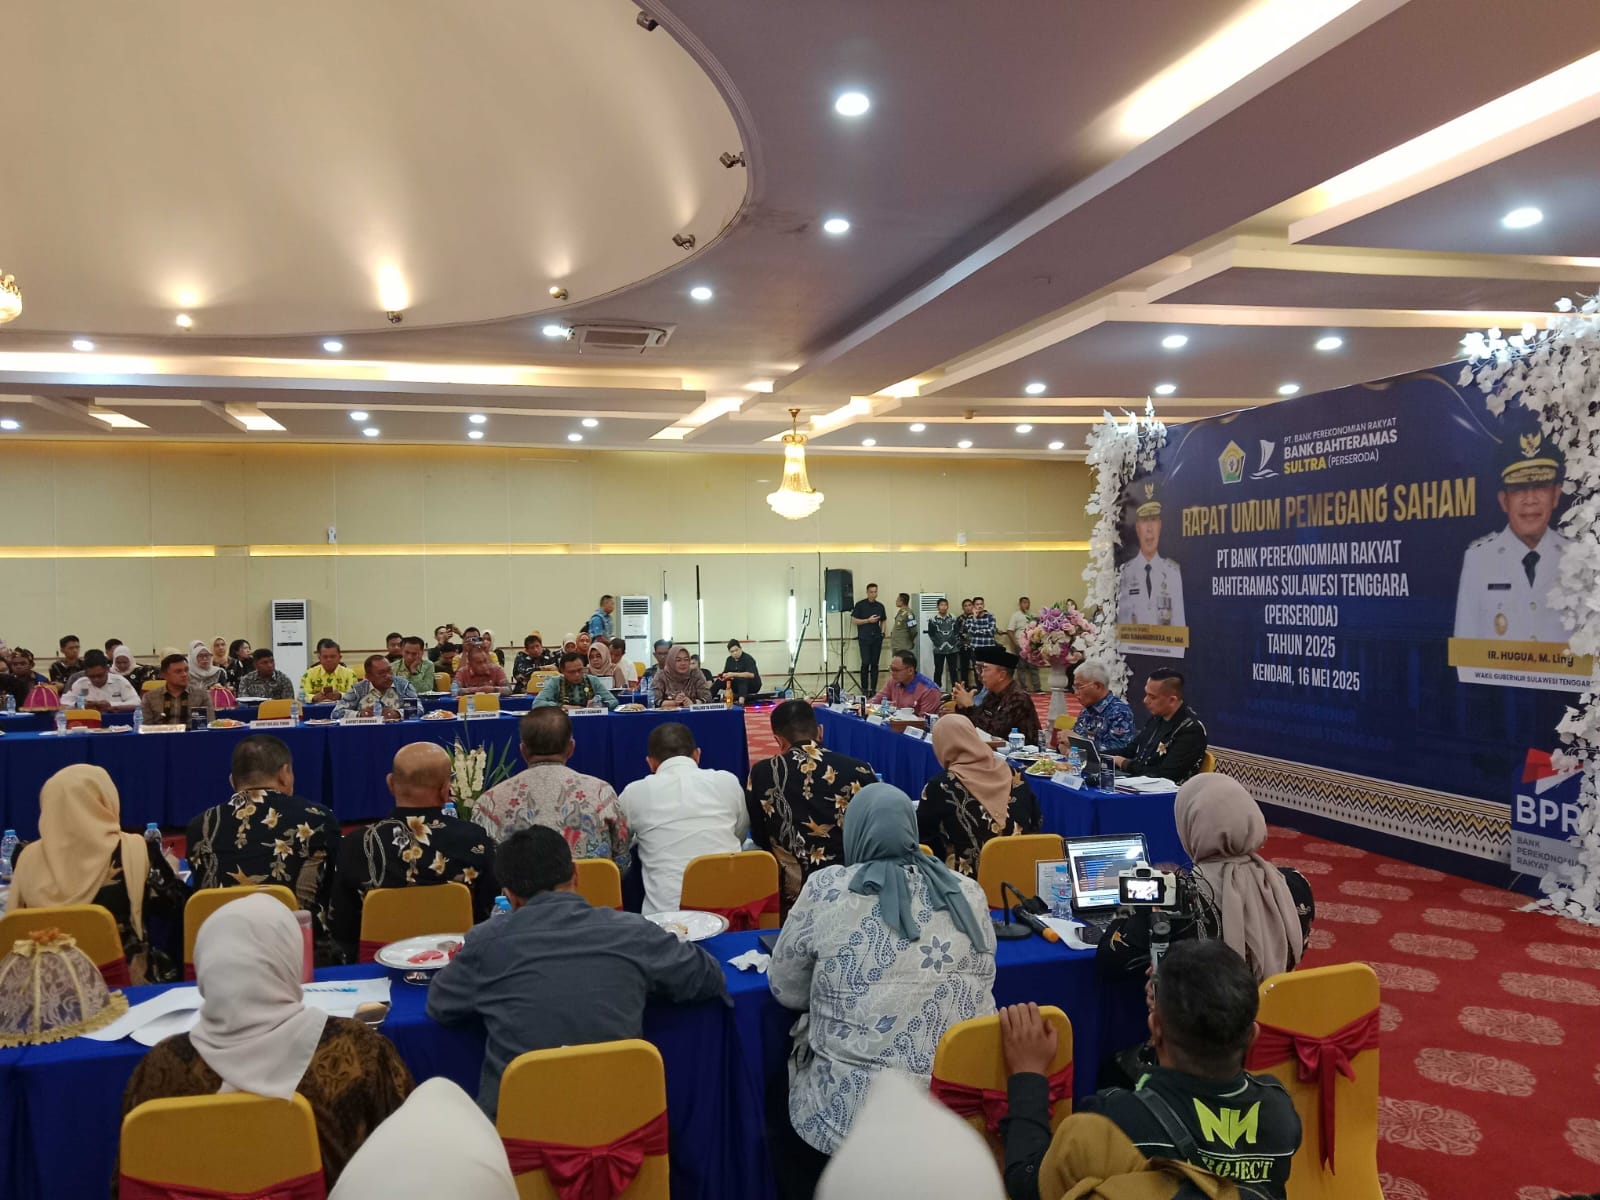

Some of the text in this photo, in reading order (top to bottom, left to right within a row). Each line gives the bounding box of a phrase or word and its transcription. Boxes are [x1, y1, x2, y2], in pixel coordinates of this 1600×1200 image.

[1294, 432, 1312, 443] BANK
[1312, 422, 1367, 439] PEREKONOMIAN
[1367, 417, 1397, 431] RAKYAT
[1283, 429, 1398, 460] BANK BAHTERAMAS
[1283, 448, 1379, 475] SULTRA (PERSERODA)
[1182, 477, 1476, 537] RAPAT UMUM PEMEGANG SAHAM
[1217, 539, 1402, 569] PT BANK PEREKONOMIAN RAKYAT
[1212, 573, 1409, 597] BAHTERAMAS SULAWESI TENGGARA
[1264, 604, 1339, 627] (PERSERODA)
[1266, 633, 1336, 658] TAHUN 2025
[1488, 651, 1499, 660] IR.
[1500, 651, 1536, 662] HUGUA,
[1538, 653, 1551, 663] M.
[1252, 663, 1360, 691] KENDARI, 16 MEI 2025
[1474, 671, 1594, 687] WAKIL GUBERNUR SULAWESI TENGGAR
[1516, 794, 1582, 834] BPR
[1516, 836, 1540, 848] BANK
[1516, 857, 1549, 871] RAKYAT
